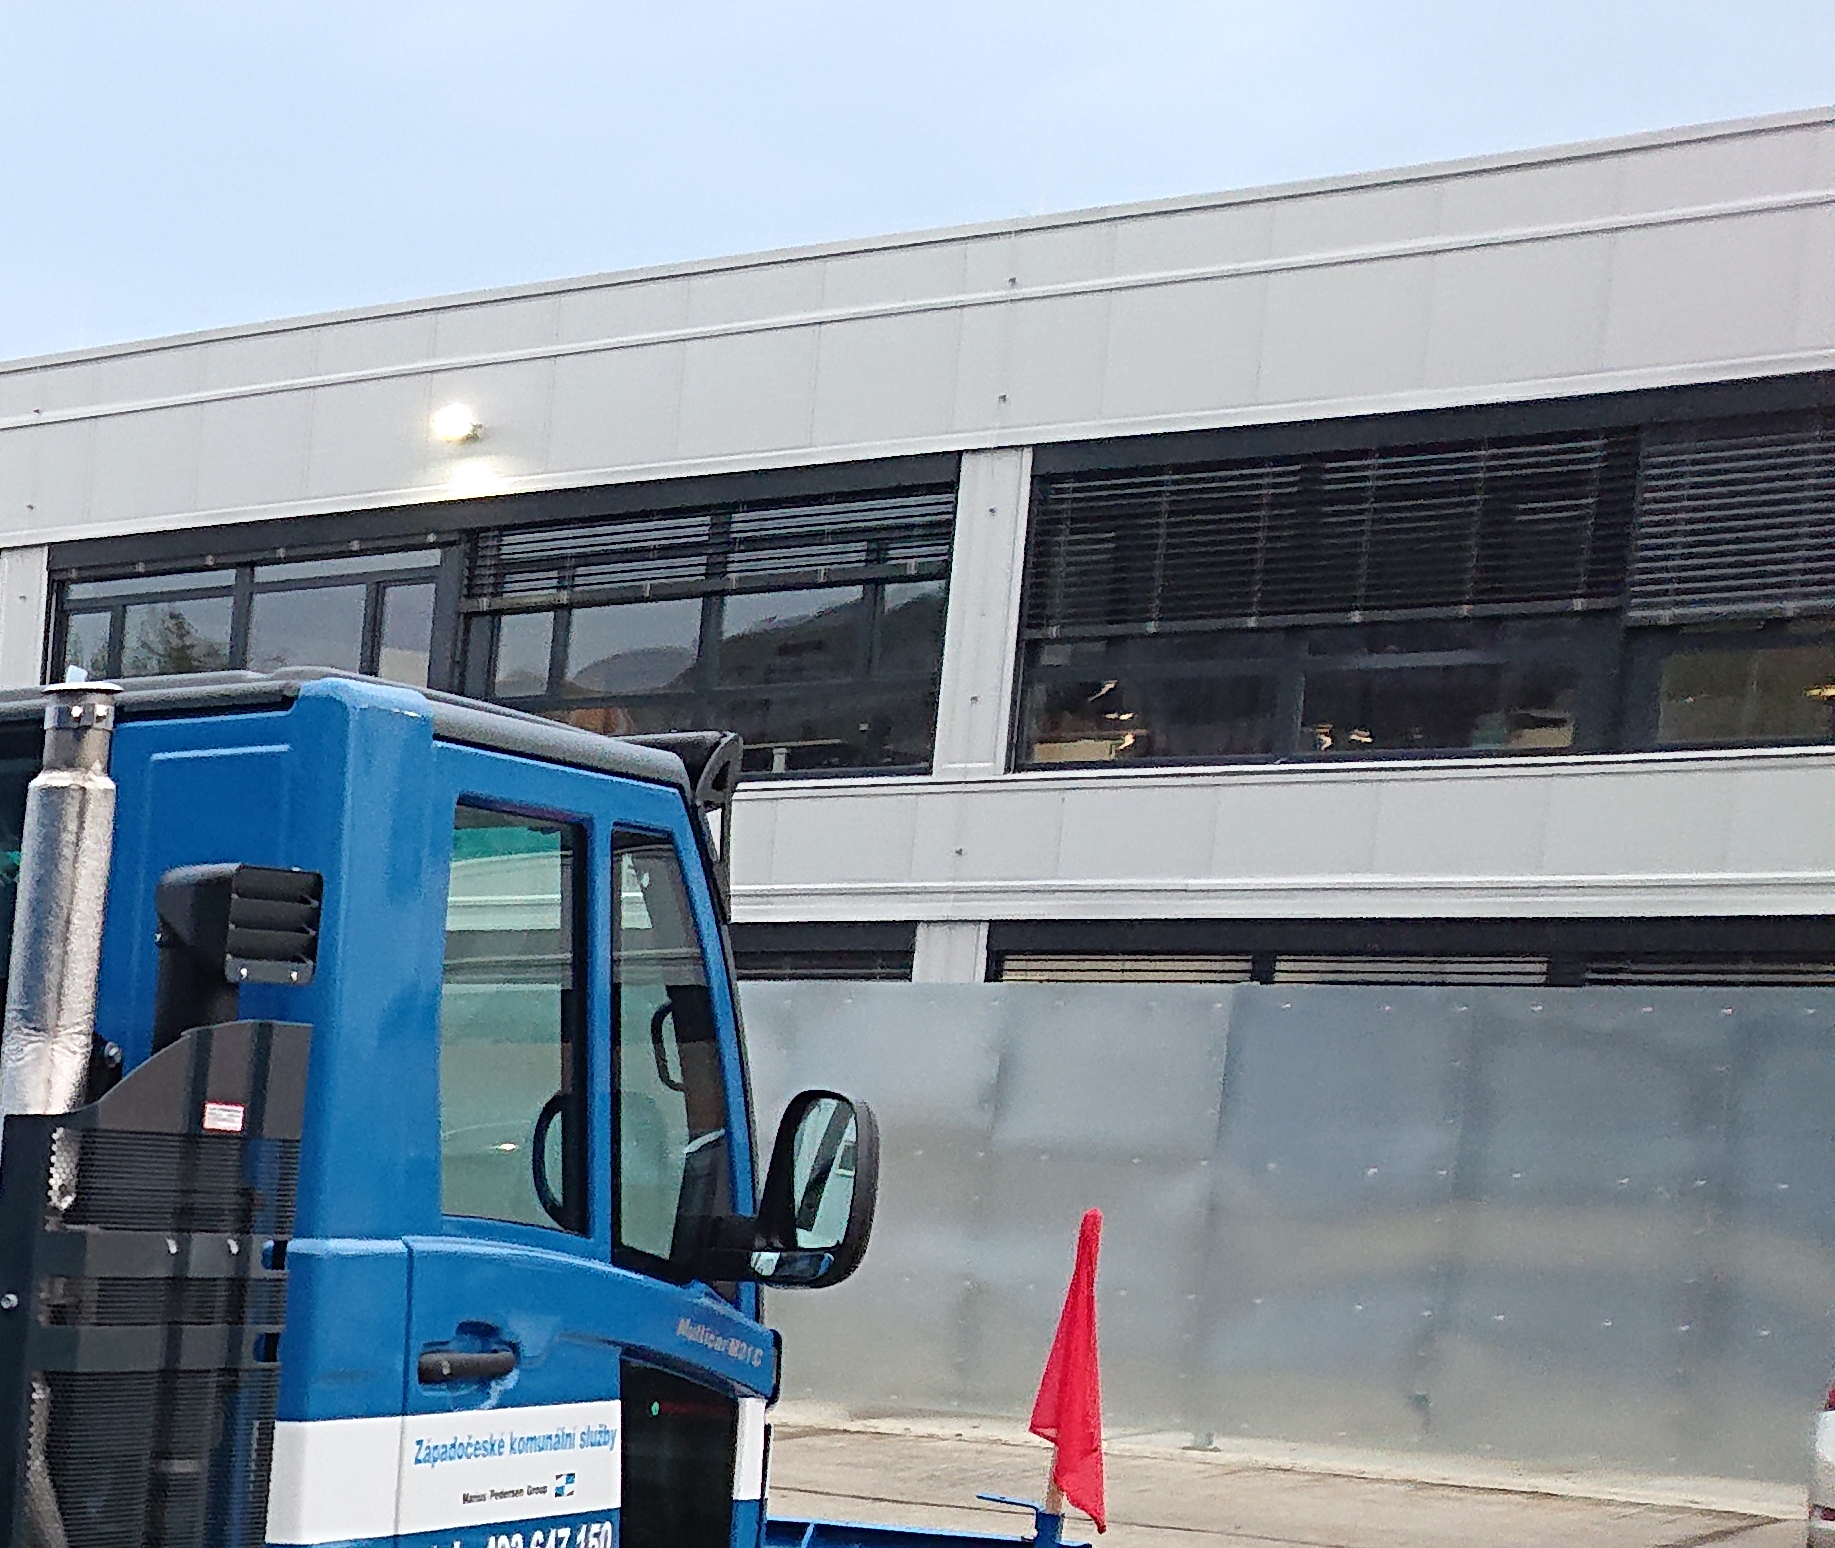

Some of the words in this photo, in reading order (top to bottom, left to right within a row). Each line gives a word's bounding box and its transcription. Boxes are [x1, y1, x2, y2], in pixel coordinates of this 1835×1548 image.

[414, 1433, 505, 1469] Západočeské
[509, 1426, 576, 1455] komunální
[579, 1423, 617, 1451] služby
[527, 1484, 548, 1496] Group
